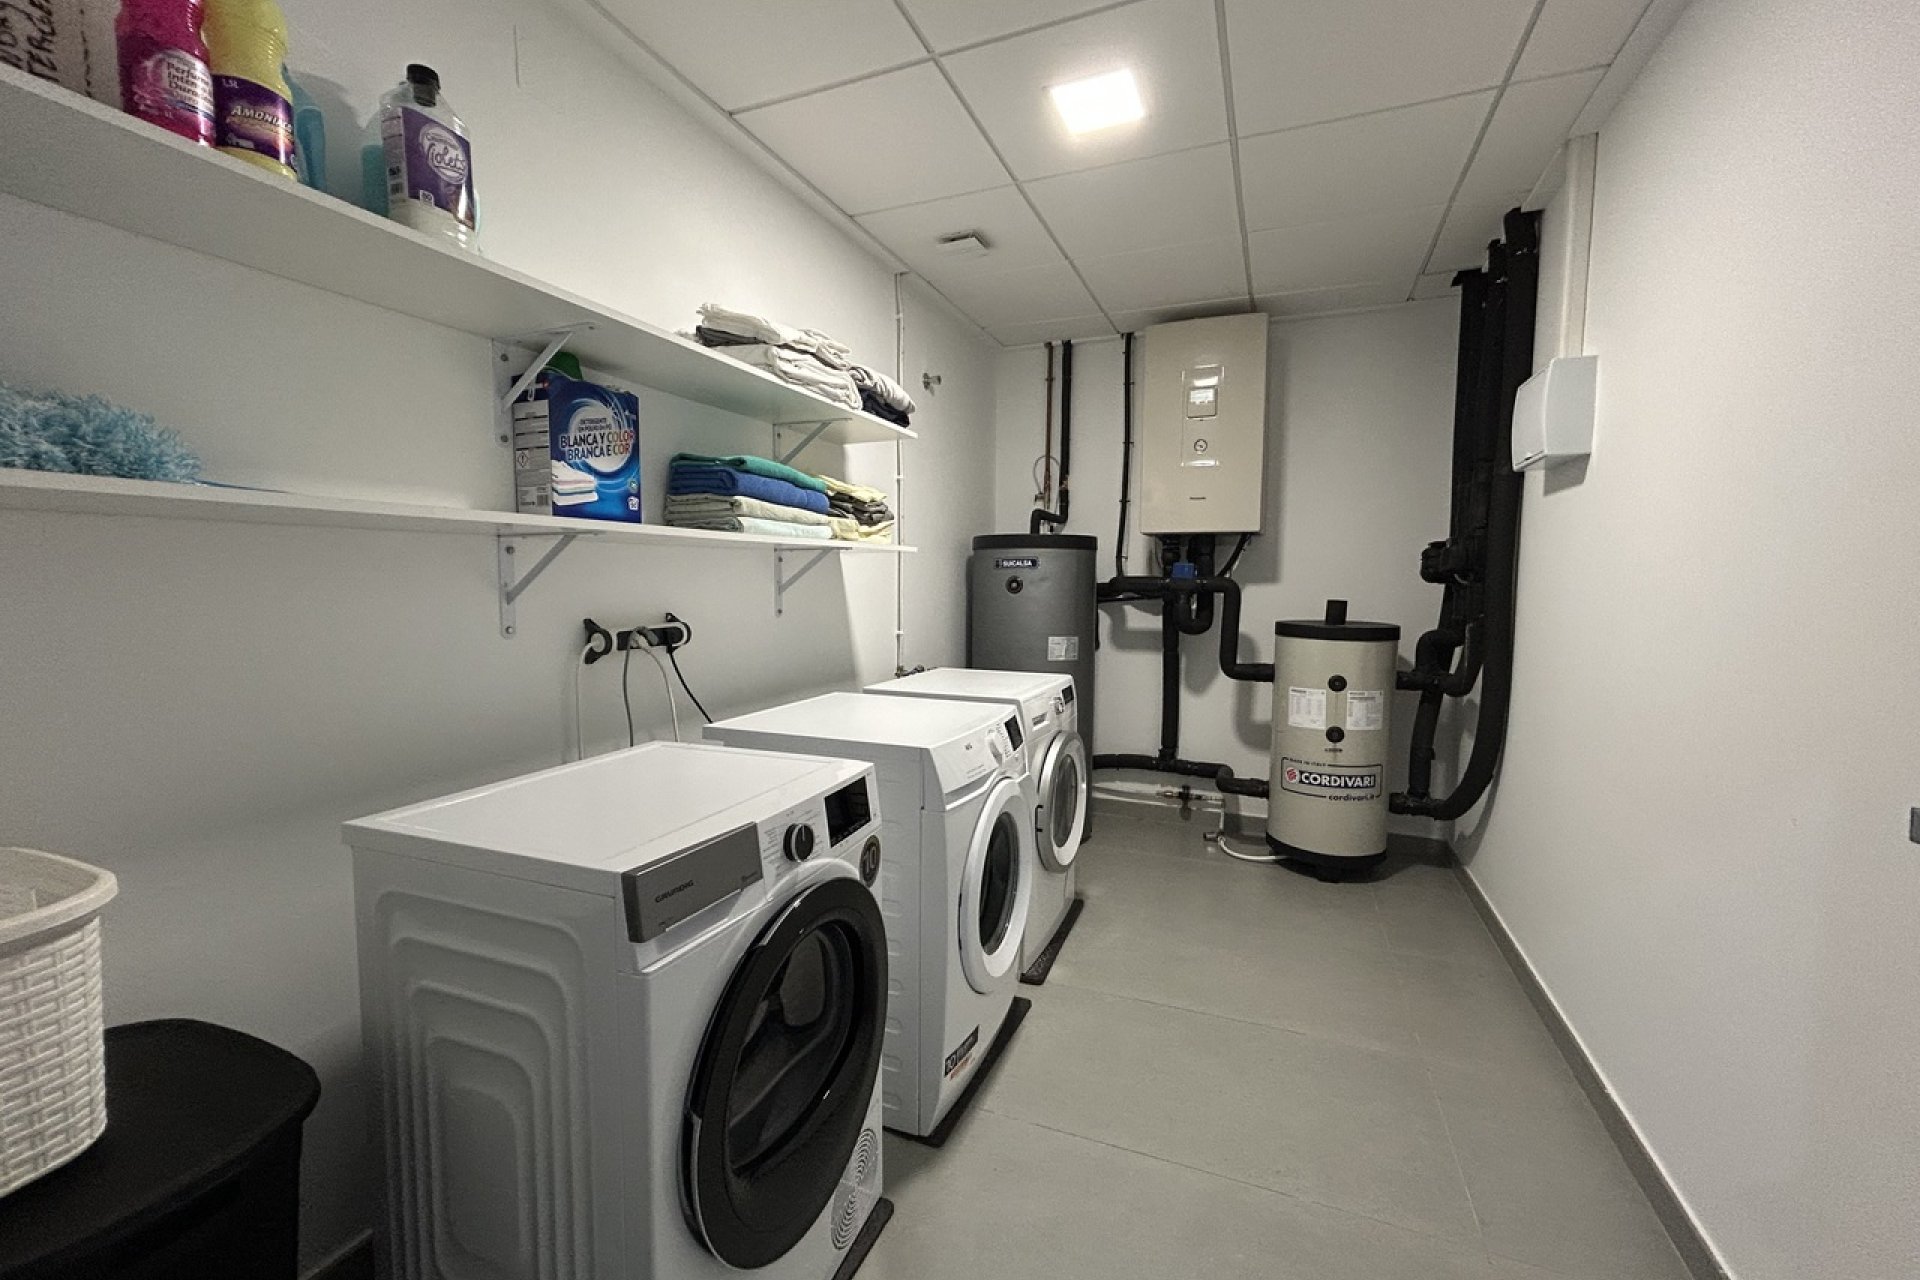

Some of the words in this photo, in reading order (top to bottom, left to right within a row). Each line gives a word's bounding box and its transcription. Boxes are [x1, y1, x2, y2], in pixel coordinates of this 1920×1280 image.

[560, 432, 598, 449] BLANCA
[599, 432, 606, 445] Y
[607, 429, 634, 444] COLOR
[567, 445, 605, 461] BRANCA
[606, 445, 612, 456] E
[613, 443, 630, 455] COR
[1301, 772, 1375, 788] CORDIVARI
